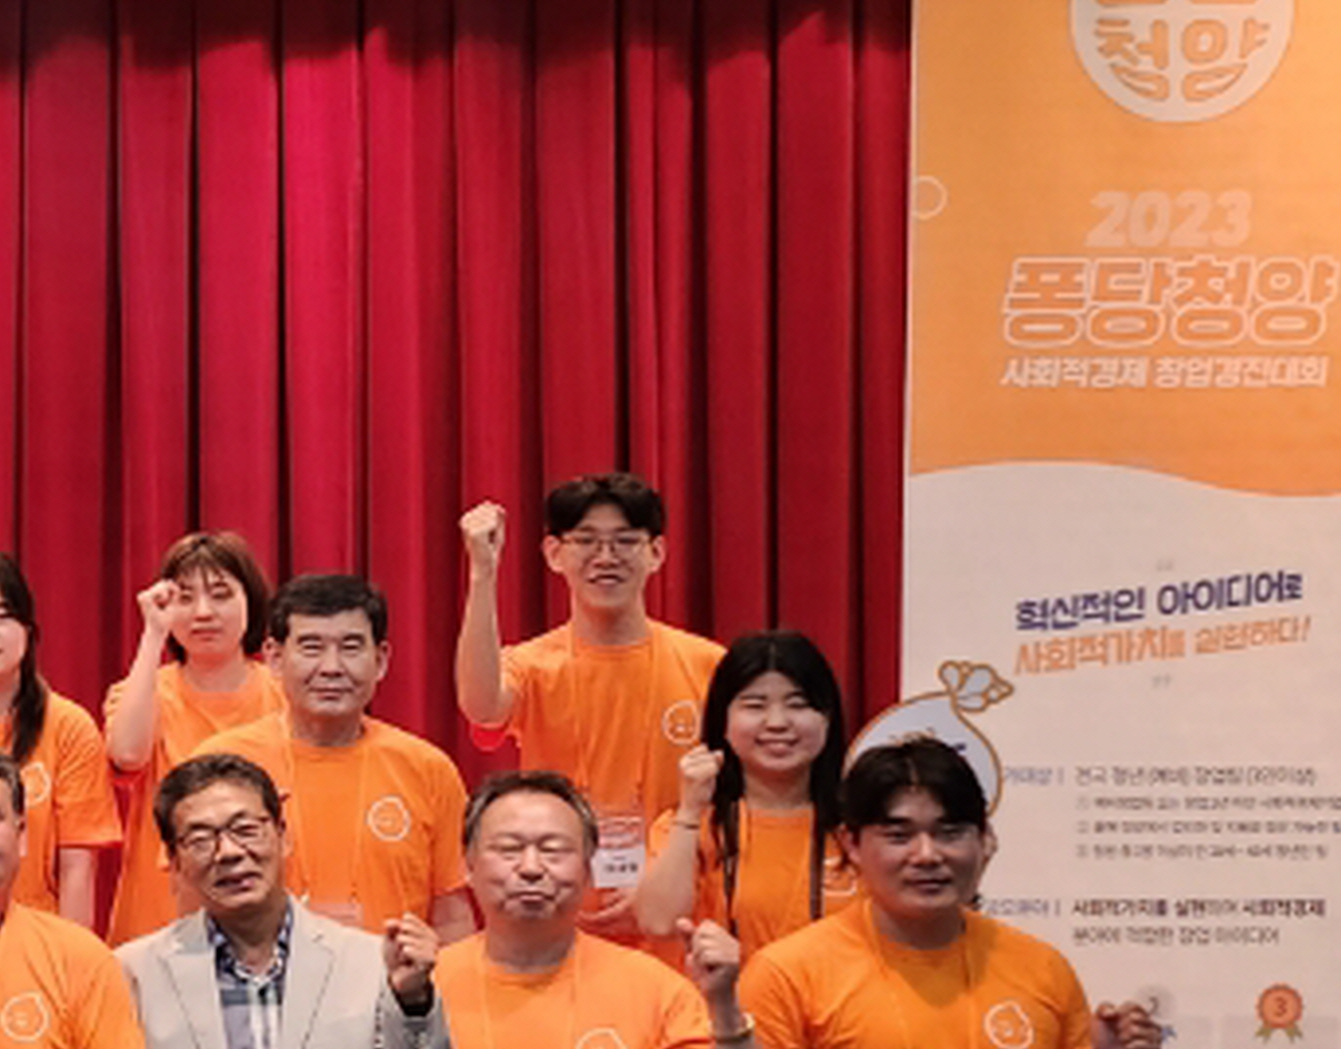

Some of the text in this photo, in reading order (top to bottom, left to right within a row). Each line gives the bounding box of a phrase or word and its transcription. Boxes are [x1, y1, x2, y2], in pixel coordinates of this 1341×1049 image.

[1094, 18, 1270, 102] 청양
[1084, 190, 1253, 248] 2023
[1001, 255, 1341, 349] 퐁당청양
[999, 355, 1329, 389] 사회적경제 창업경진대회
[1015, 569, 1304, 632] 혁신적인 아이디어로
[1013, 615, 1312, 676] 사회적가치를 실현하다!
[1274, 998, 1289, 1018] 3
